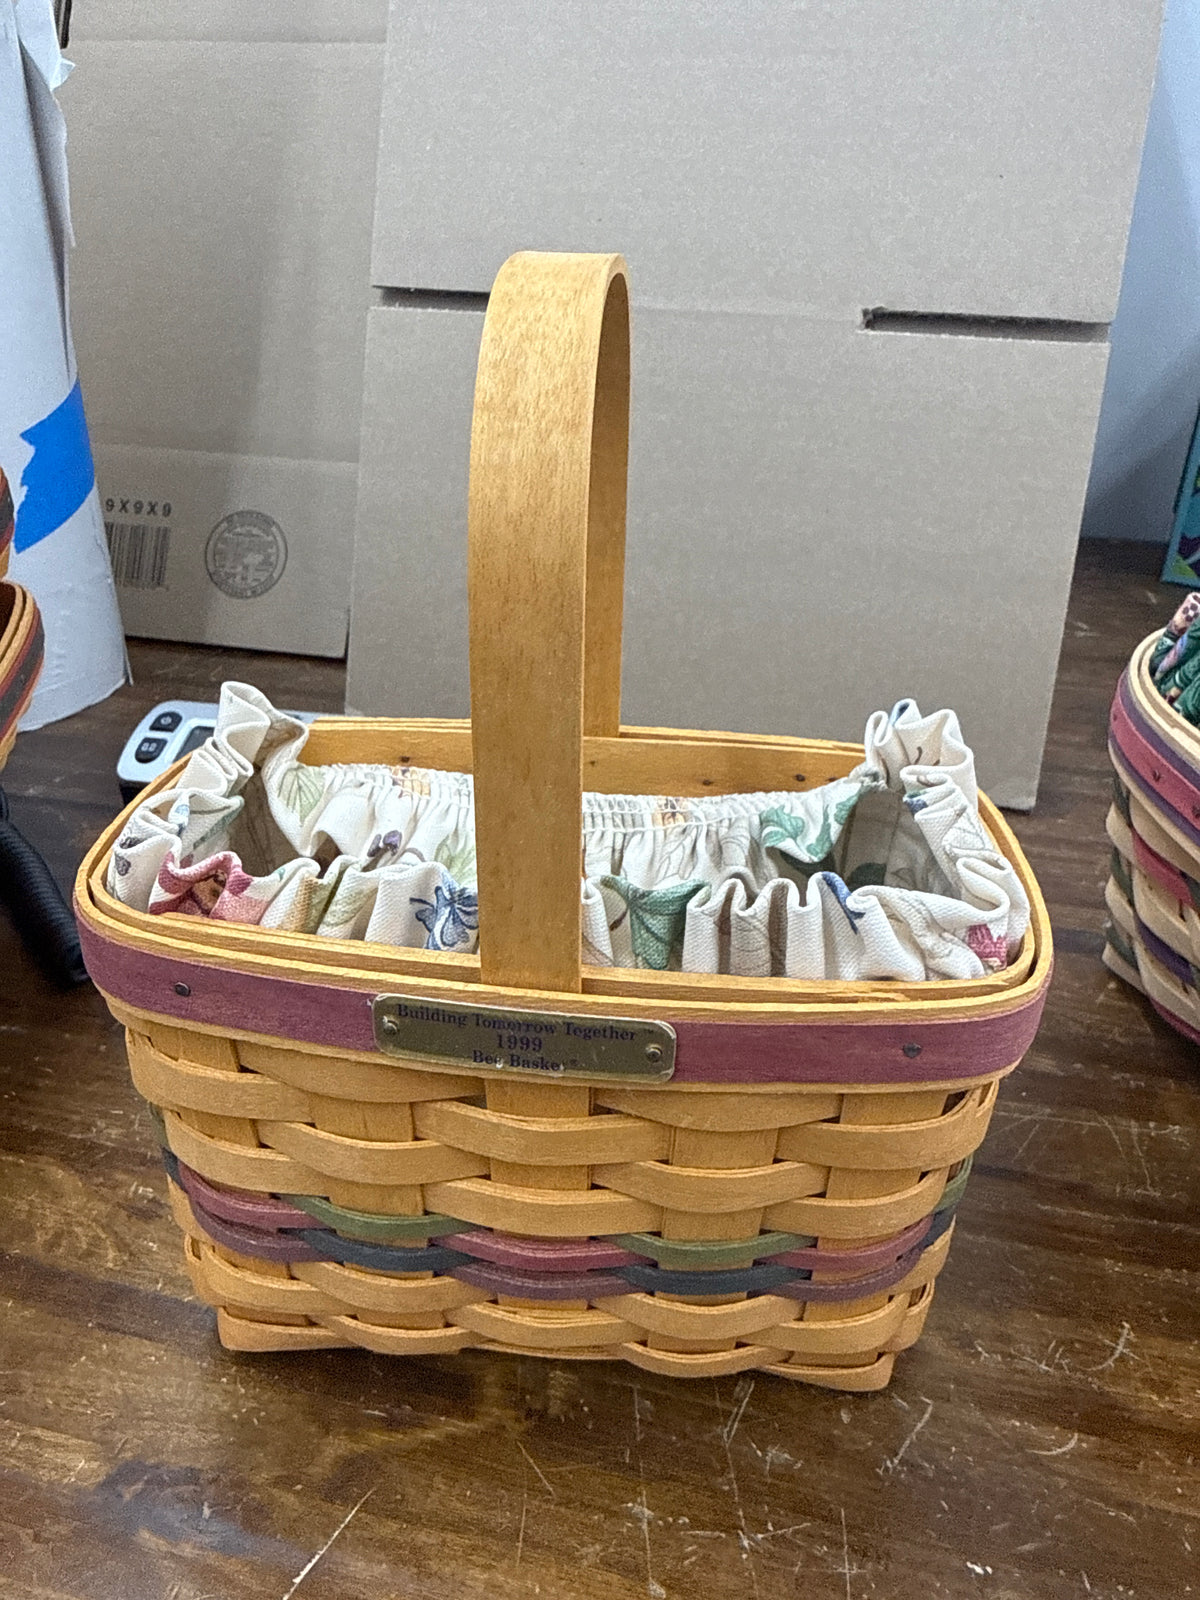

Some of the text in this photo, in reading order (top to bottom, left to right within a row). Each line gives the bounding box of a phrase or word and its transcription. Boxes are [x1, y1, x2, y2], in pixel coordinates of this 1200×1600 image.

[397, 1003, 468, 1028] Building
[472, 1012, 555, 1034] Tomorrow
[563, 1021, 636, 1041] Together
[497, 1034, 543, 1052] 1999
